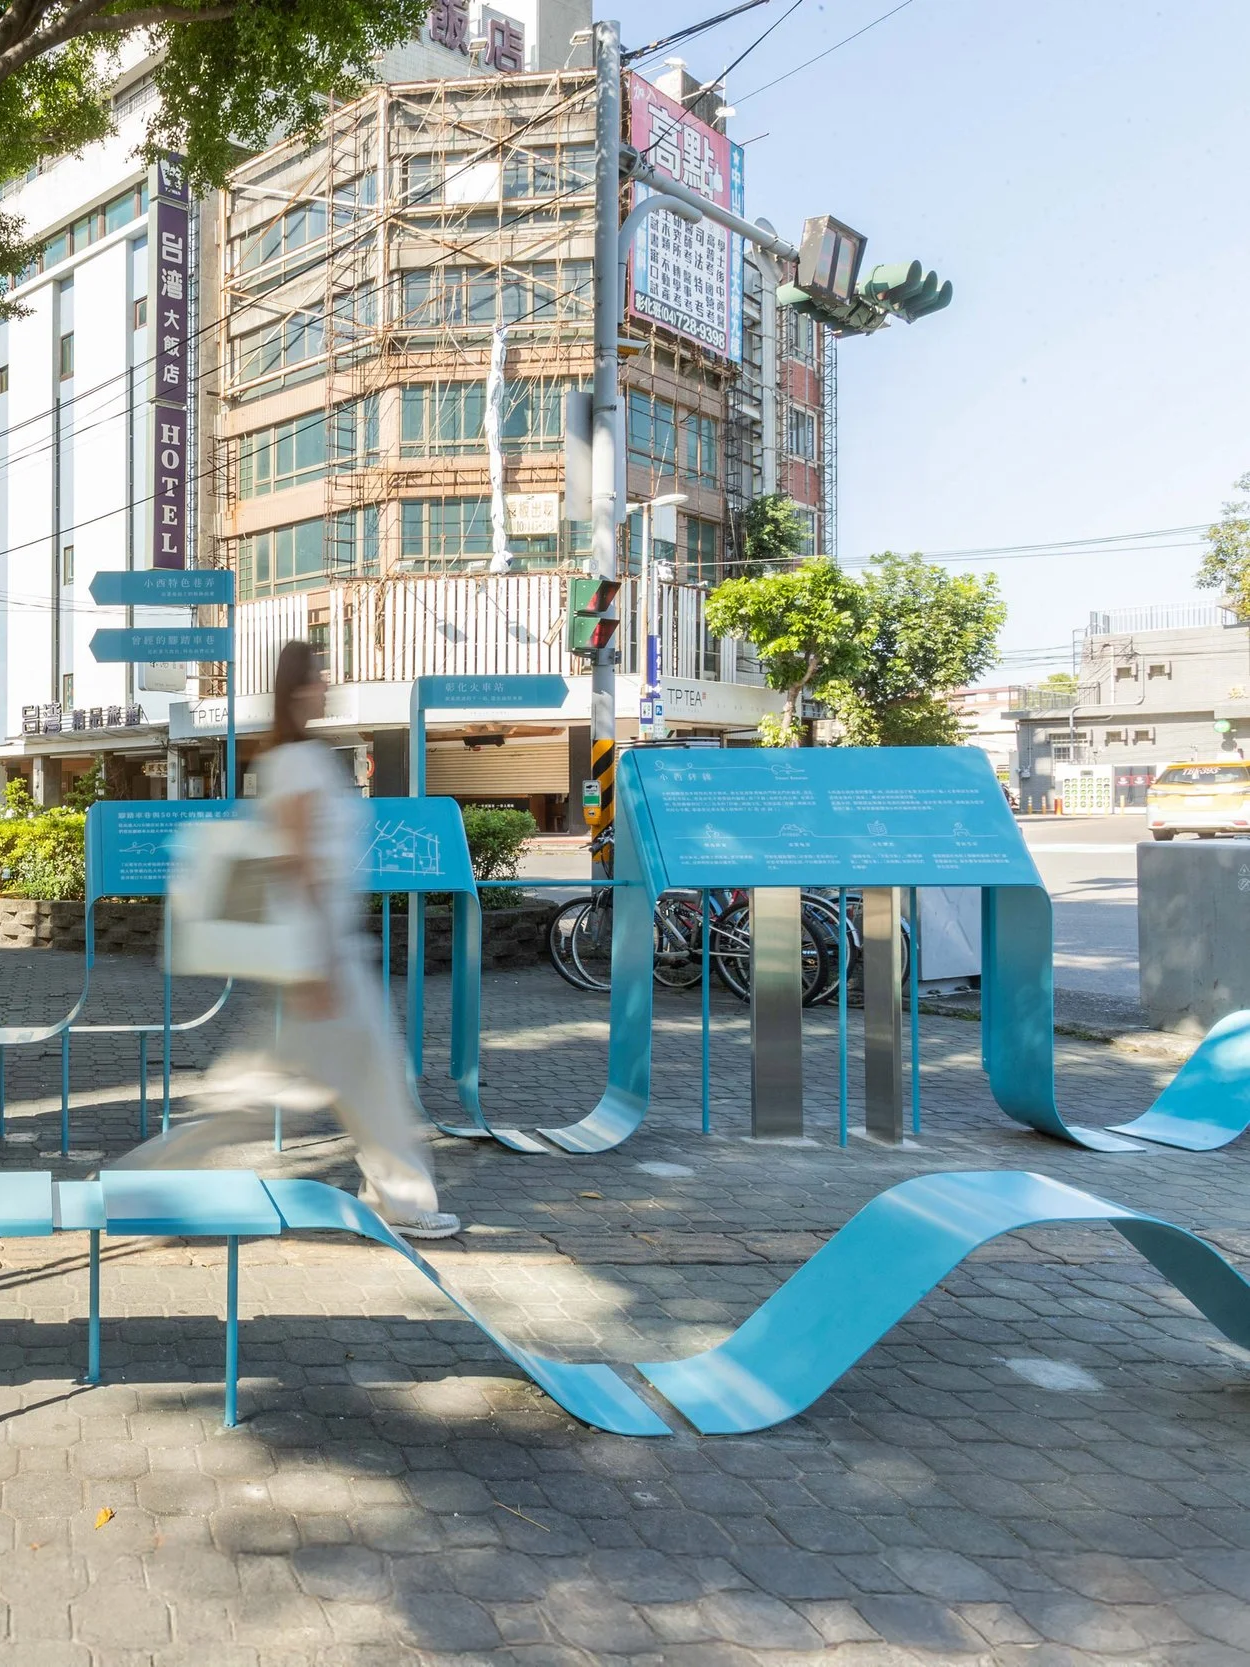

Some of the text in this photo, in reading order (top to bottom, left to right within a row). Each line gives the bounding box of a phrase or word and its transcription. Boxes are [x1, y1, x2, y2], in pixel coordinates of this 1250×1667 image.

[429, 0, 522, 74] 飯店
[648, 102, 715, 201] 高點
[694, 226, 705, 318] 司法特考
[160, 423, 181, 554] HOTEL
[144, 577, 215, 588] 小西特色巷弄
[445, 682, 505, 693] 彰化火車站
[667, 688, 703, 707] TP TEA
